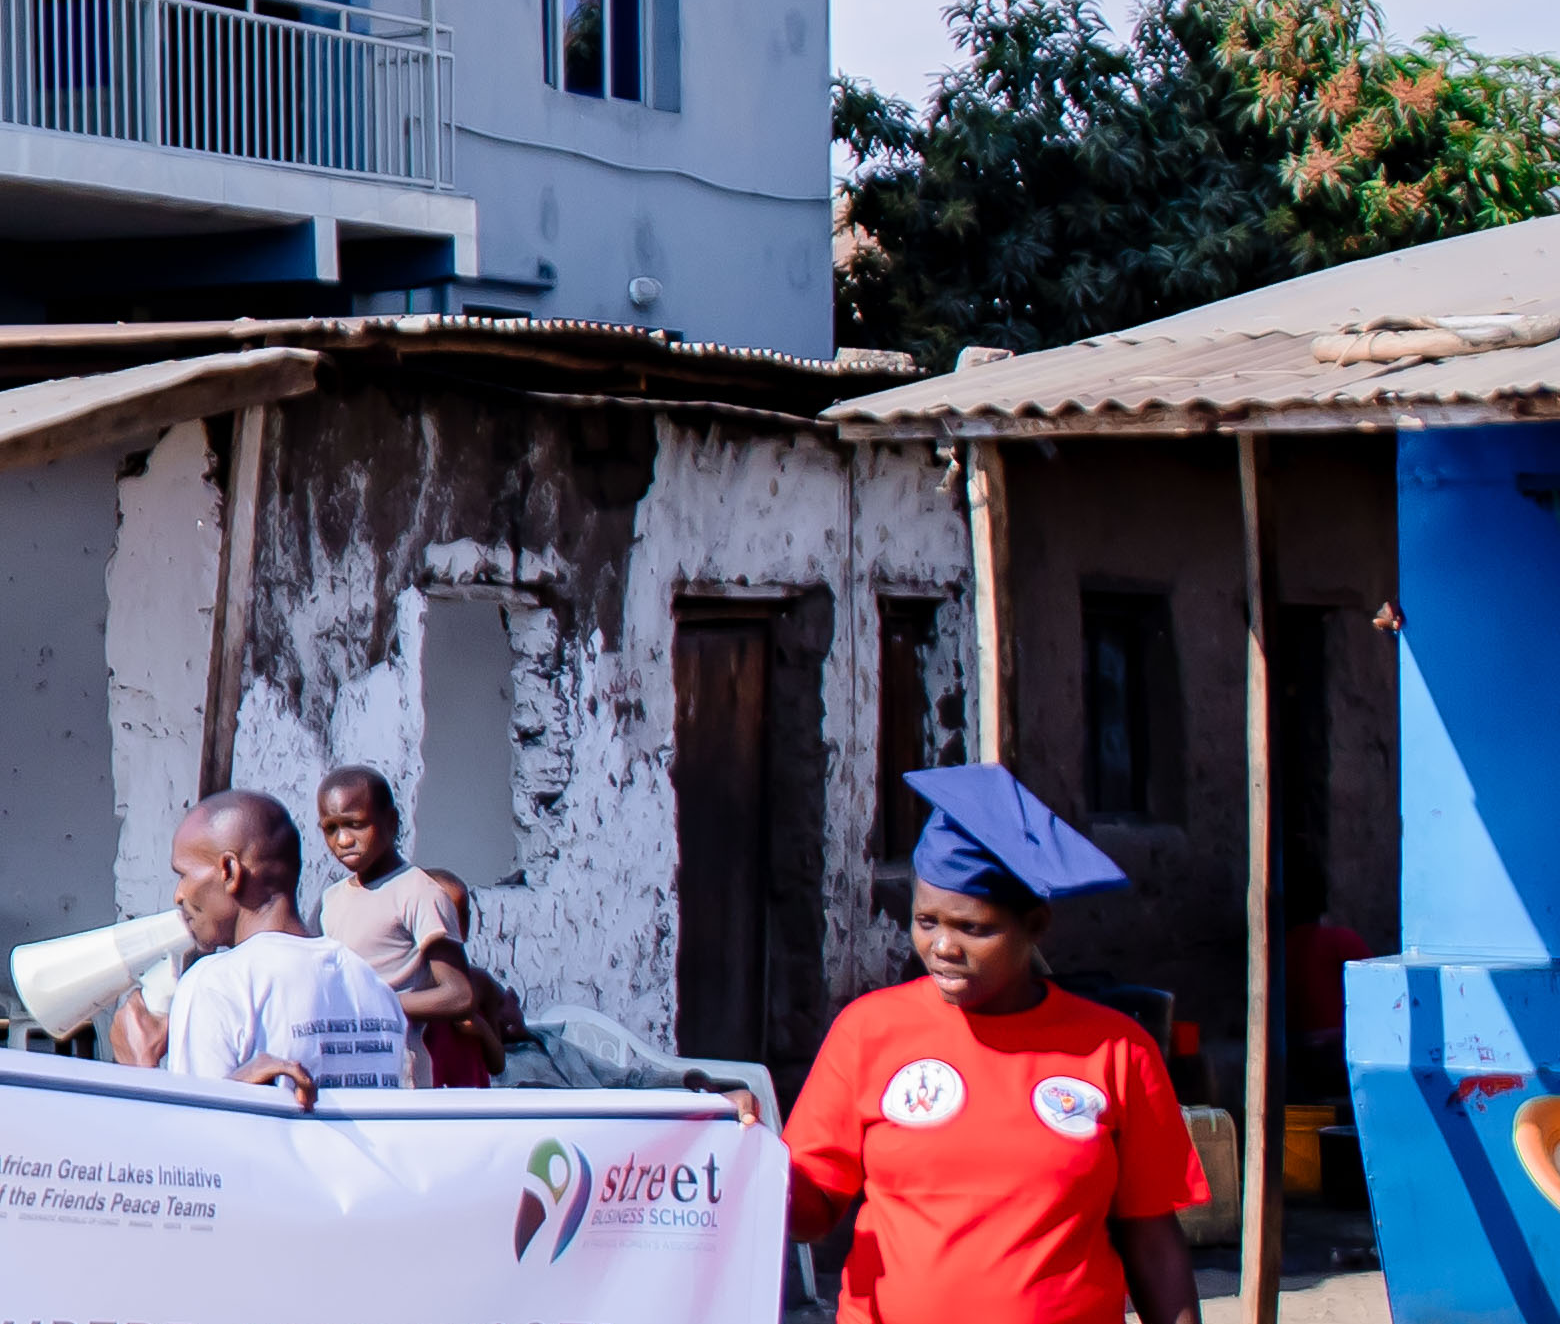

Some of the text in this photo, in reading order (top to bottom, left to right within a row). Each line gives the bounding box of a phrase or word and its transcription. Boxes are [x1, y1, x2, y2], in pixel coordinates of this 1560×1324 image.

[57, 1159, 102, 1182] Great
[108, 1161, 154, 1185] Lakes
[158, 1164, 222, 1188] Initiative
[599, 1152, 722, 1204] street
[8, 1185, 36, 1207] the
[41, 1187, 105, 1212] Friends
[110, 1192, 161, 1216] Peace
[166, 1195, 216, 1219] Teams
[591, 1207, 718, 1228] BUSINESS SCHOOL
